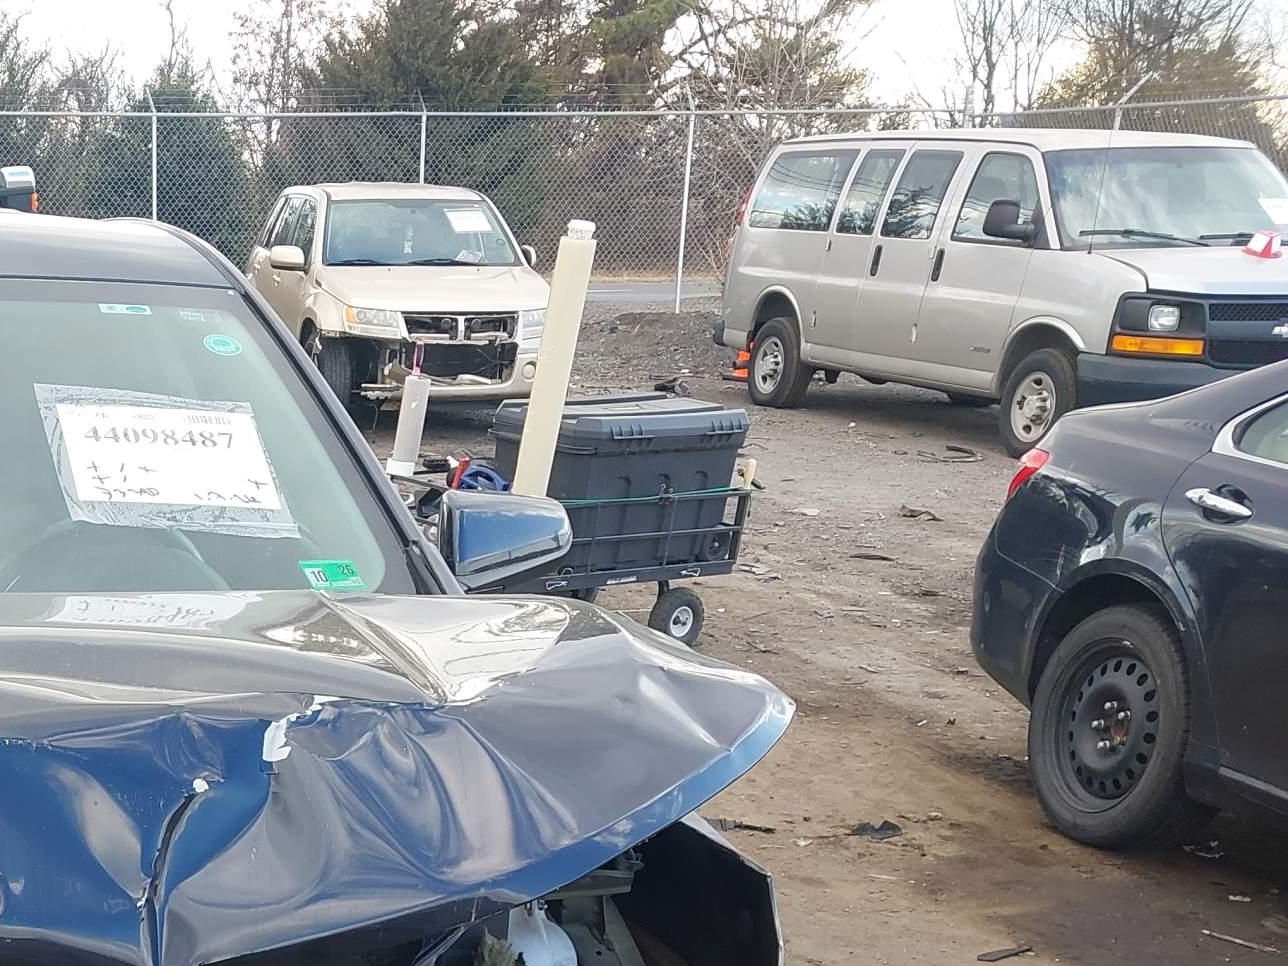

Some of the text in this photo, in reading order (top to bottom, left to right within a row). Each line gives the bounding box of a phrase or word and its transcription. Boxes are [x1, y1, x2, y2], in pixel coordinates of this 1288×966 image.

[83, 425, 234, 449] 44098487
[310, 570, 329, 583] 10
[338, 564, 355, 577] 26
